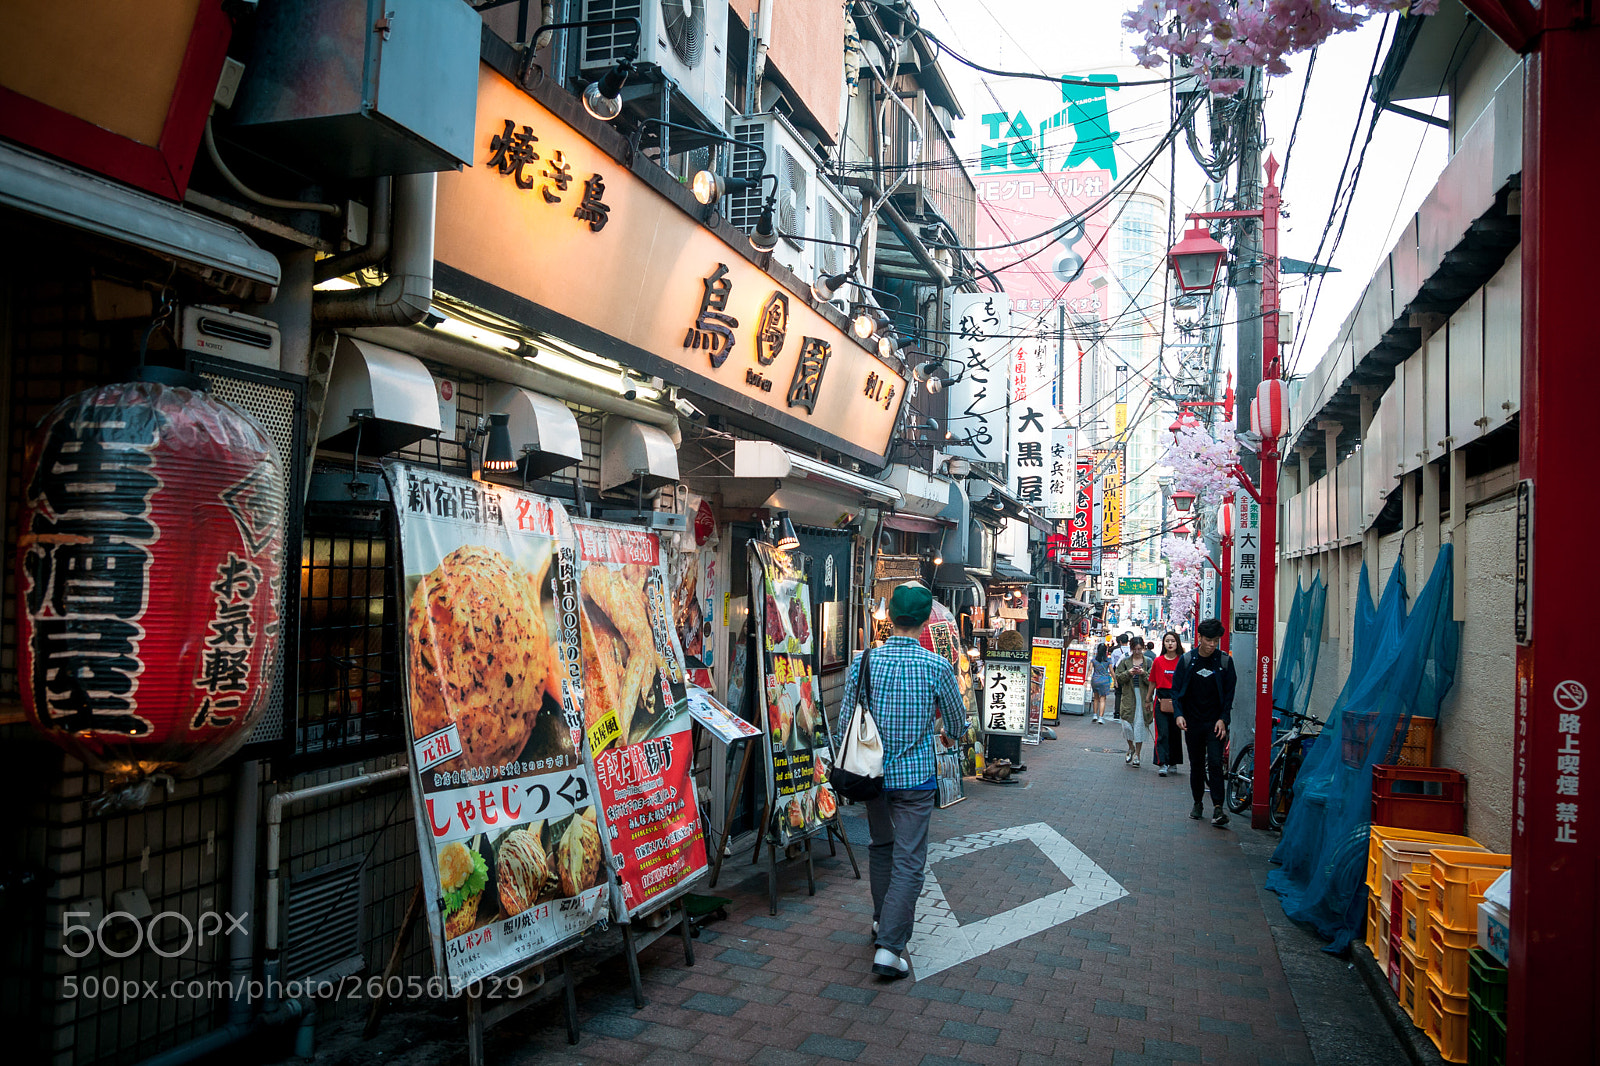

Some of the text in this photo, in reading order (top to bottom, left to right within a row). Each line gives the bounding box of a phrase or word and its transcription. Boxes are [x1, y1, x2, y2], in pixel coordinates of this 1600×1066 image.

[486, 119, 612, 233] 焼き鳥
[1008, 298, 1103, 312] 産を面くする
[1014, 347, 1028, 401] 全国地酒
[1017, 406, 1044, 502] 大黒屋
[1049, 443, 1065, 495] 安兵衛
[407, 474, 554, 535] 新宿鳥園 名物
[1239, 495, 1249, 529] 全国地酒
[1239, 532, 1257, 590] 大黒屋
[191, 553, 263, 731] お気軽に
[987, 672, 1008, 731] 大黒屋
[421, 733, 453, 764] 元祖
[1554, 713, 1581, 844] 路上喫煙 禁止
